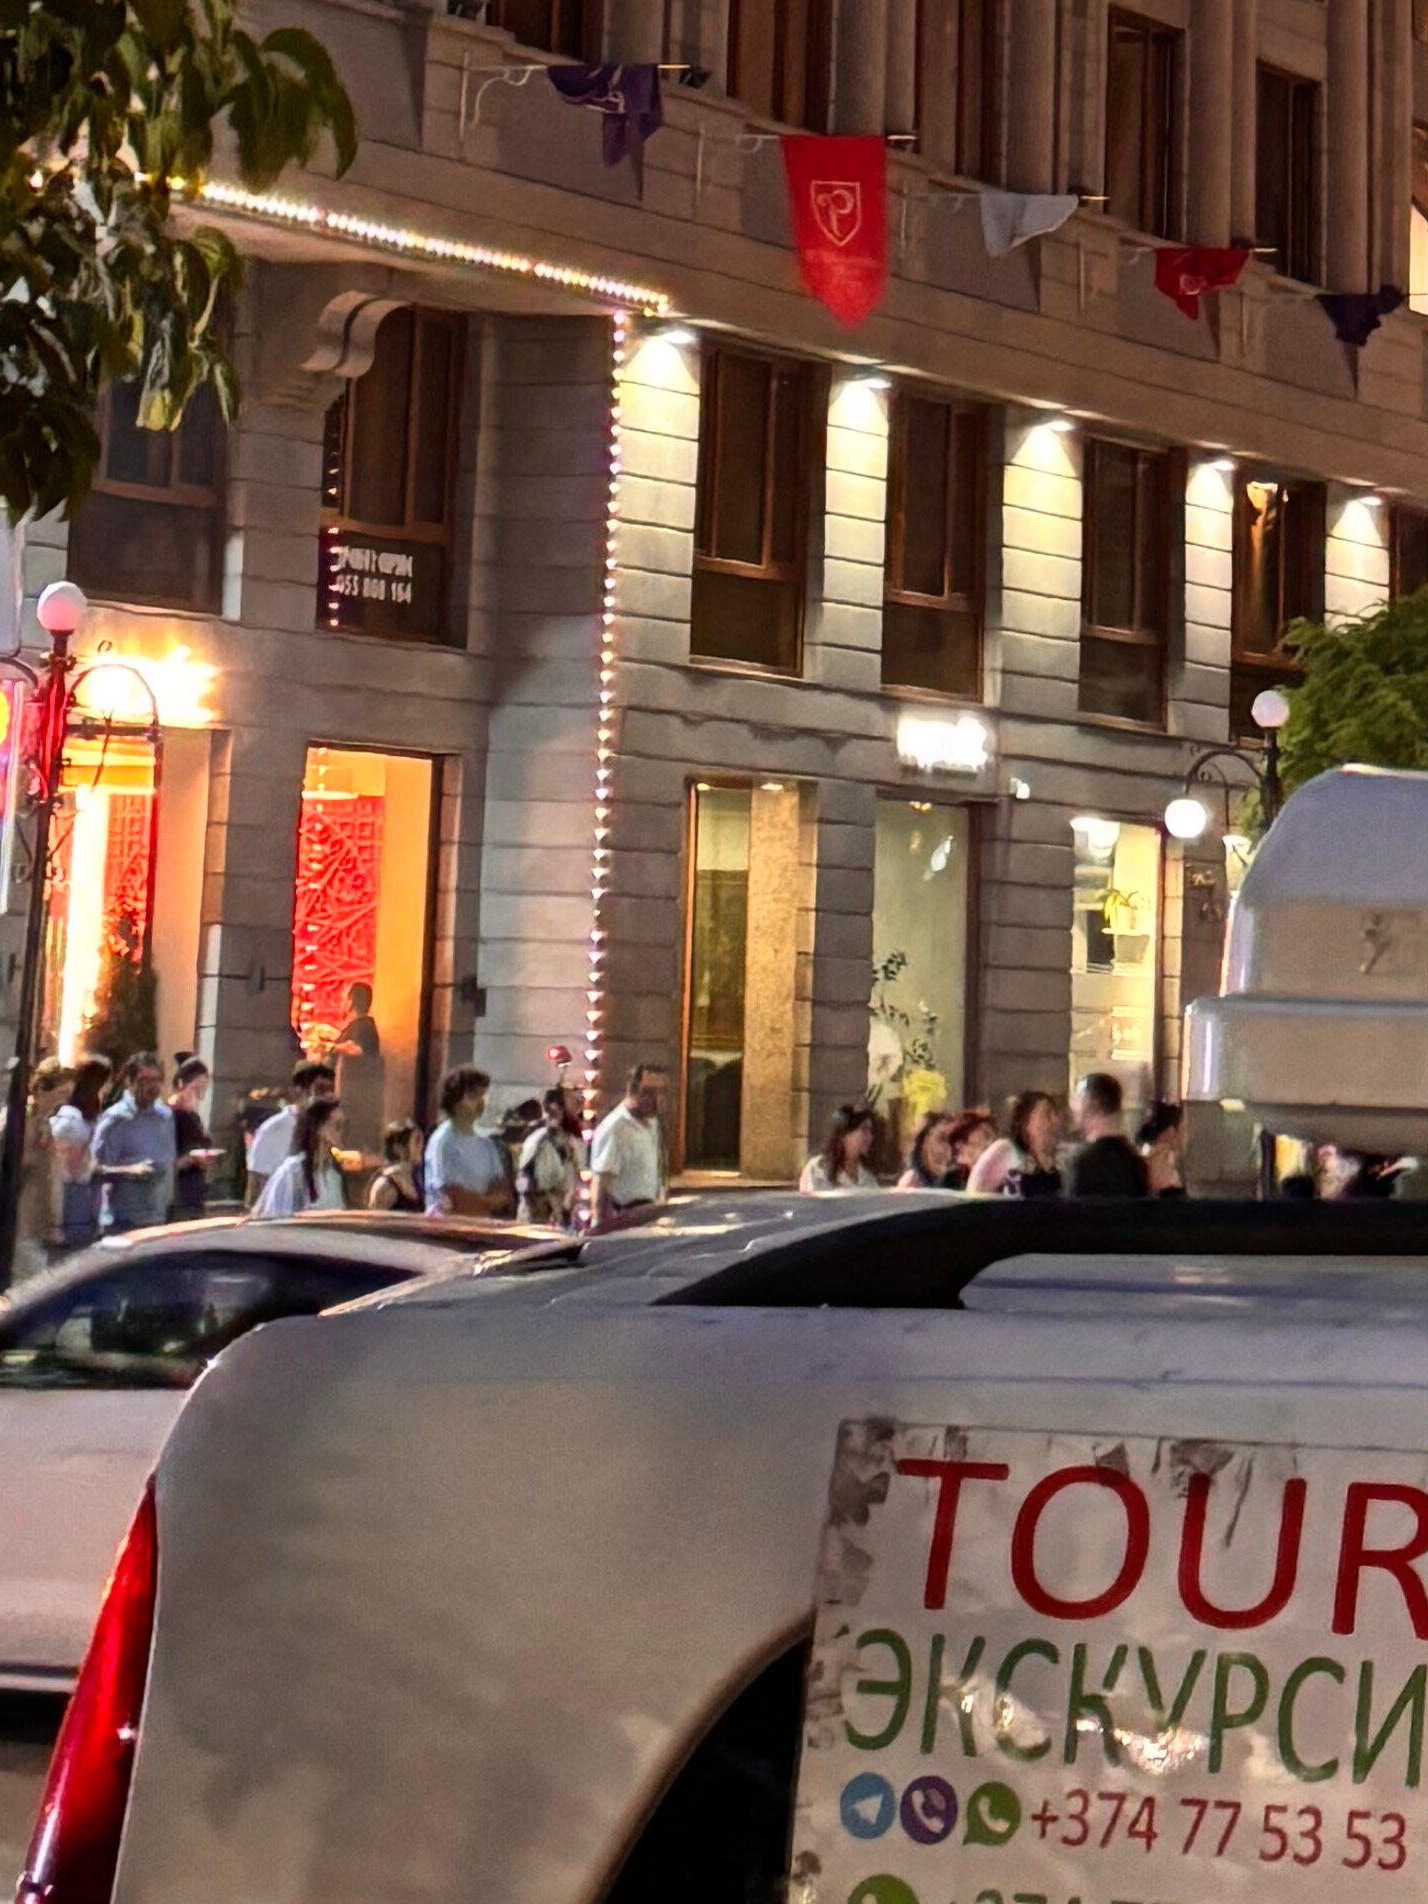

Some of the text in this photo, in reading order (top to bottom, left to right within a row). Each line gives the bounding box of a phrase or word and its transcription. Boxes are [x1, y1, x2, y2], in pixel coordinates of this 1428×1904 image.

[1031, 1788, 1160, 1853] +374
[1180, 1797, 1242, 1857] 77
[1259, 1803, 1323, 1867] 53
[1342, 1809, 1407, 1871] 53
